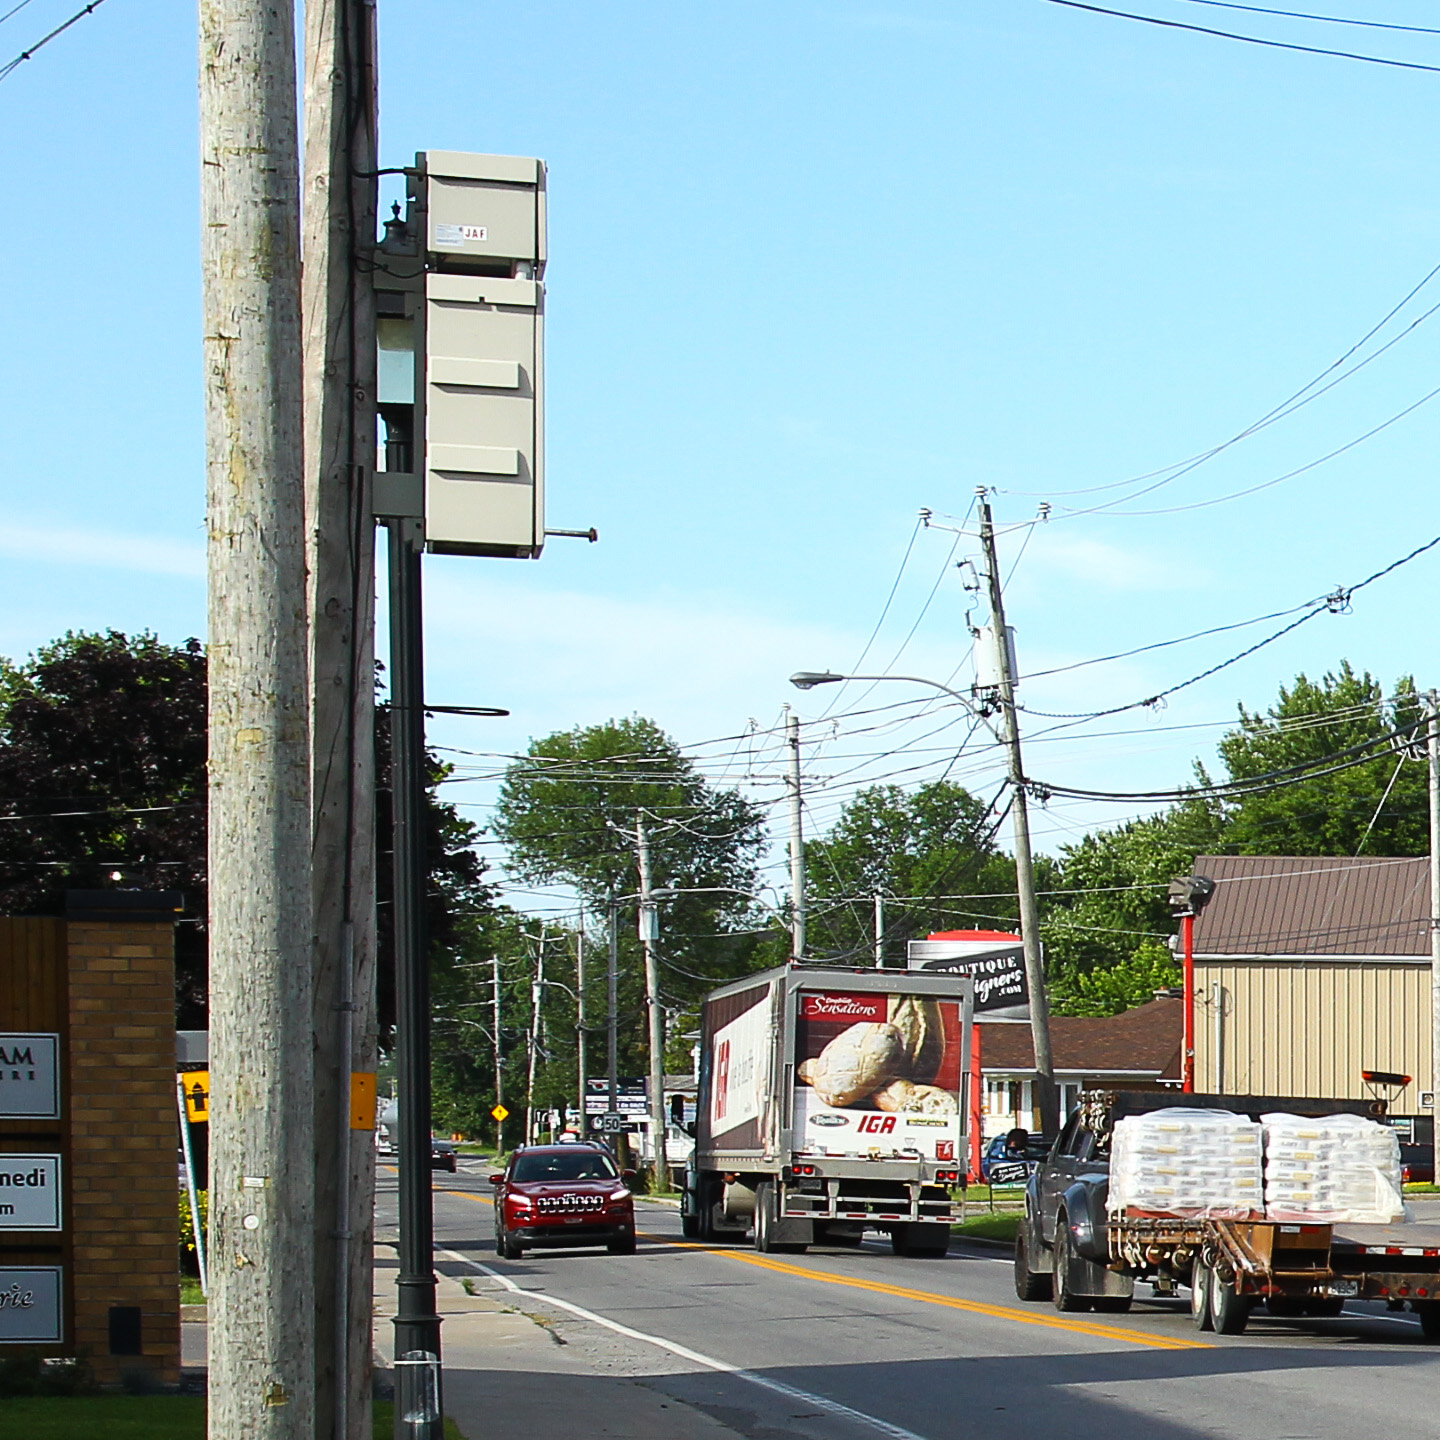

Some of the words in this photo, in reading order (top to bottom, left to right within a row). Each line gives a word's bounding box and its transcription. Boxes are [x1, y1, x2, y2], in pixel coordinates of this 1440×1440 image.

[465, 228, 485, 239] JAF
[973, 968, 1024, 1003] igners
[998, 984, 1022, 997] .COM
[804, 996, 878, 1016] Sensations
[605, 1118, 619, 1131] 50
[857, 1115, 897, 1134] IGA
